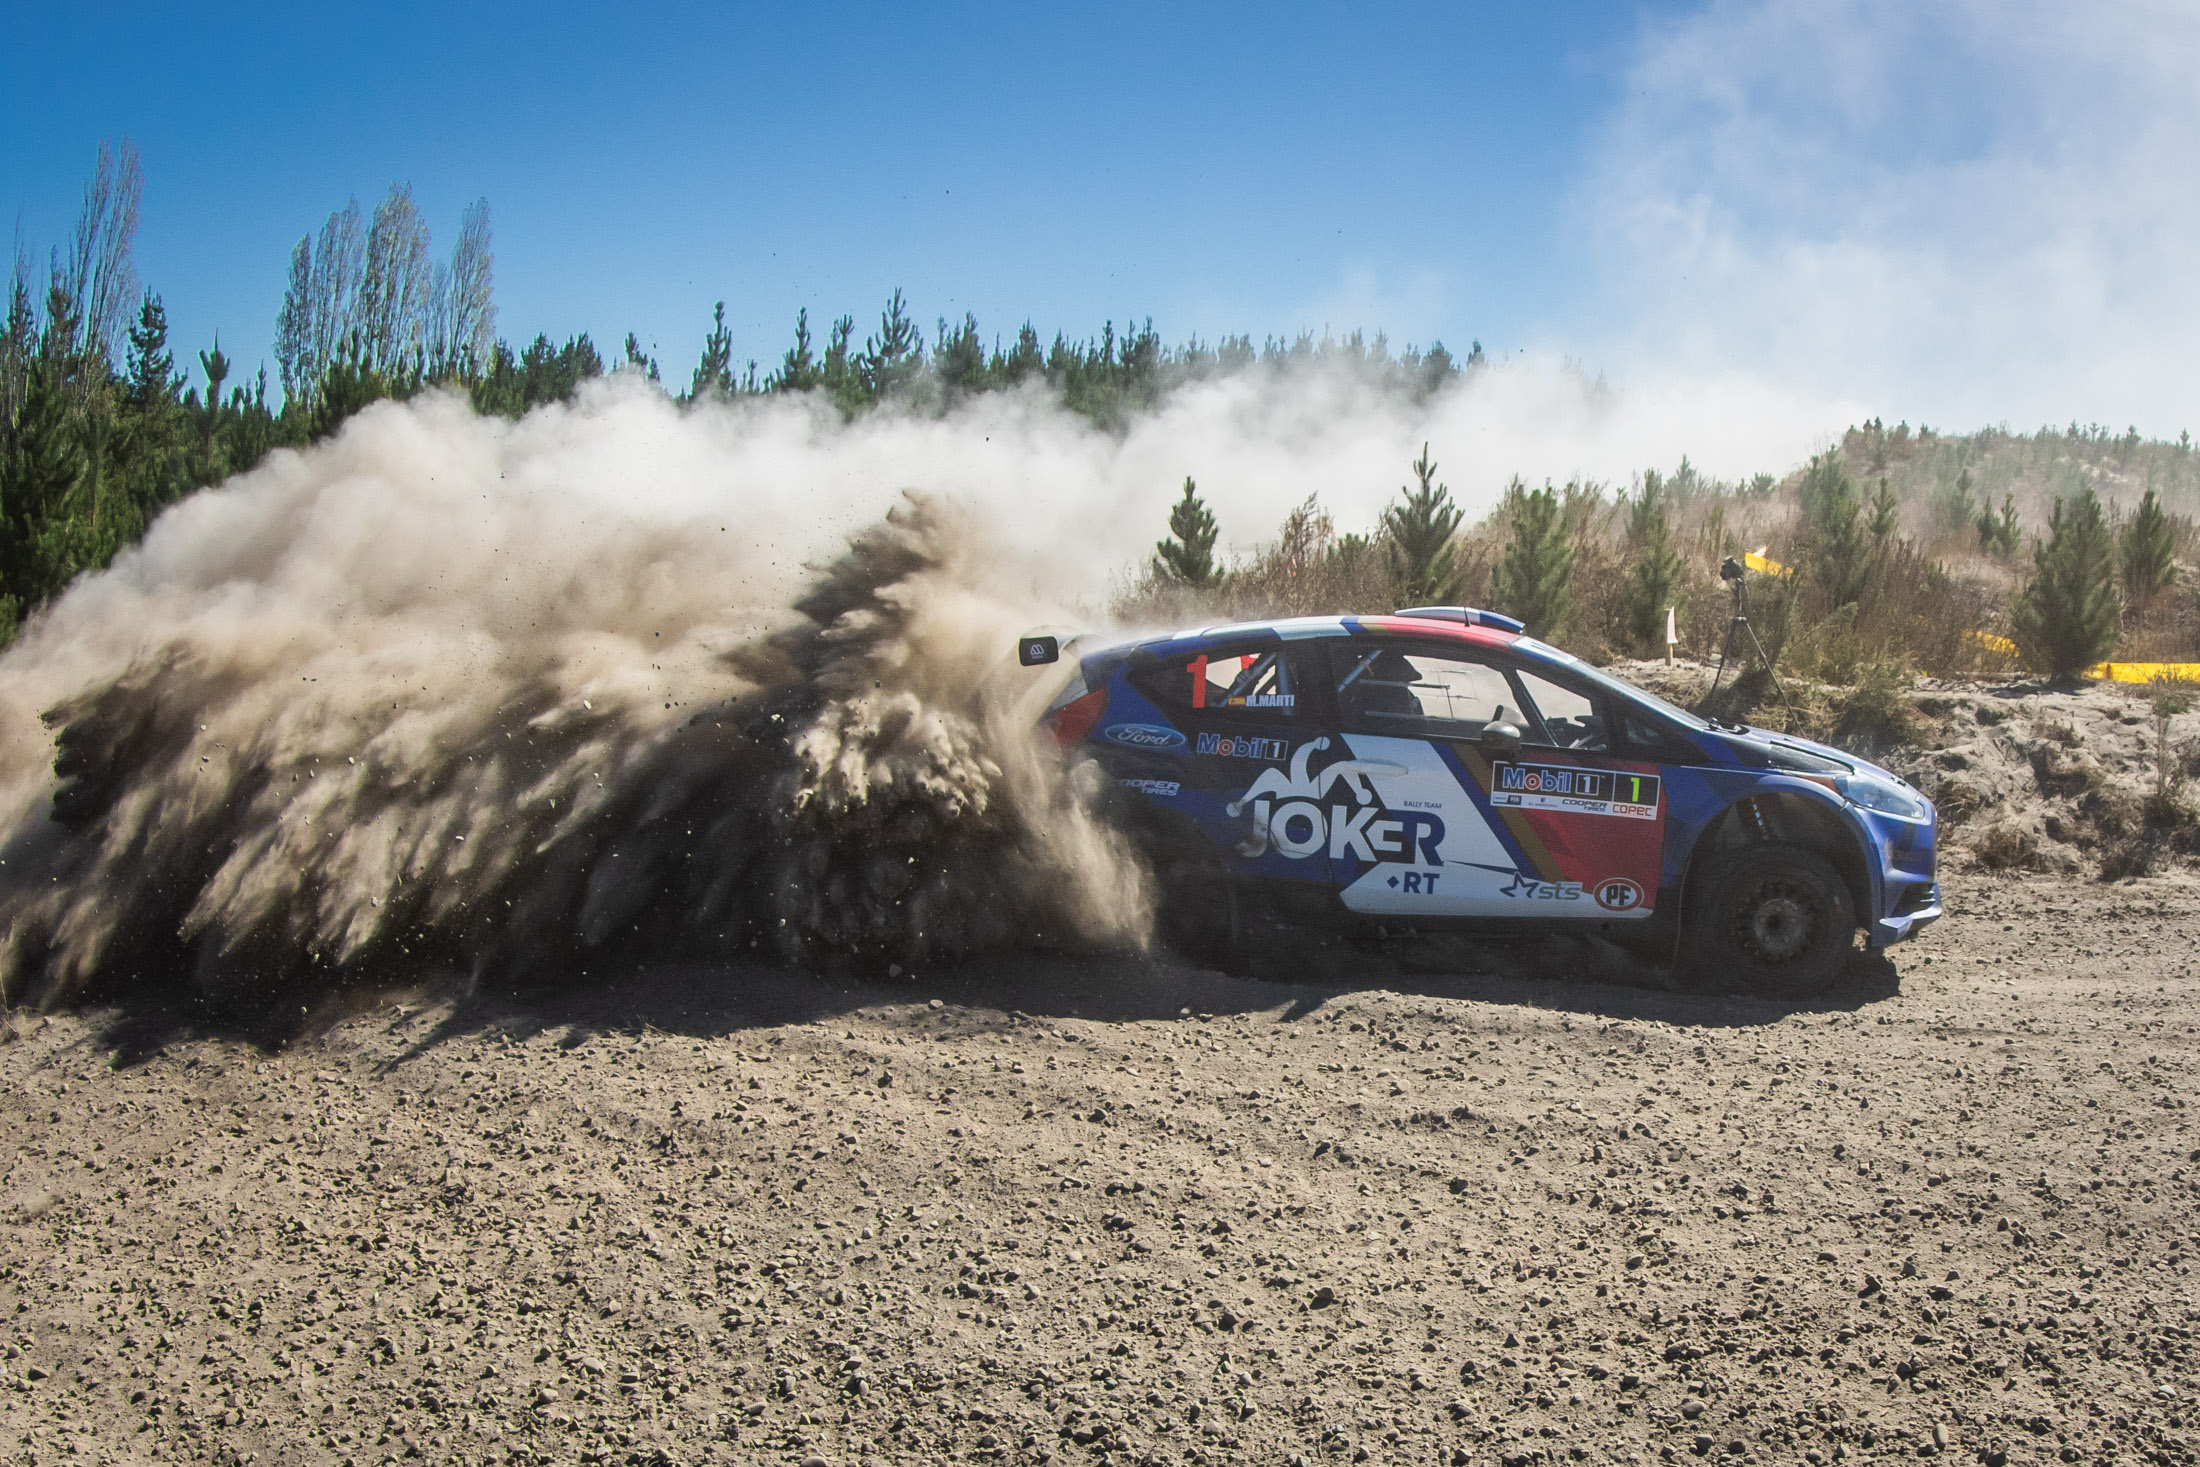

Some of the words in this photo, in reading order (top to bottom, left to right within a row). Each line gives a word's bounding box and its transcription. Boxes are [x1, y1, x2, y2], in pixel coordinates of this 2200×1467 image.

[1186, 655, 1208, 708] 1
[1246, 694, 1295, 707] M.MARTI
[1117, 726, 1172, 746] Ford
[1196, 733, 1265, 759] Mobil
[1502, 767, 1572, 794] Mobil
[1630, 777, 1641, 803] 1
[1403, 801, 1423, 809] RALLY
[1561, 799, 1608, 809] COOPER
[1238, 799, 1446, 867] JOKER
[1403, 871, 1440, 895] RT
[1538, 882, 1582, 900] sts
[1606, 884, 1632, 906] PF
